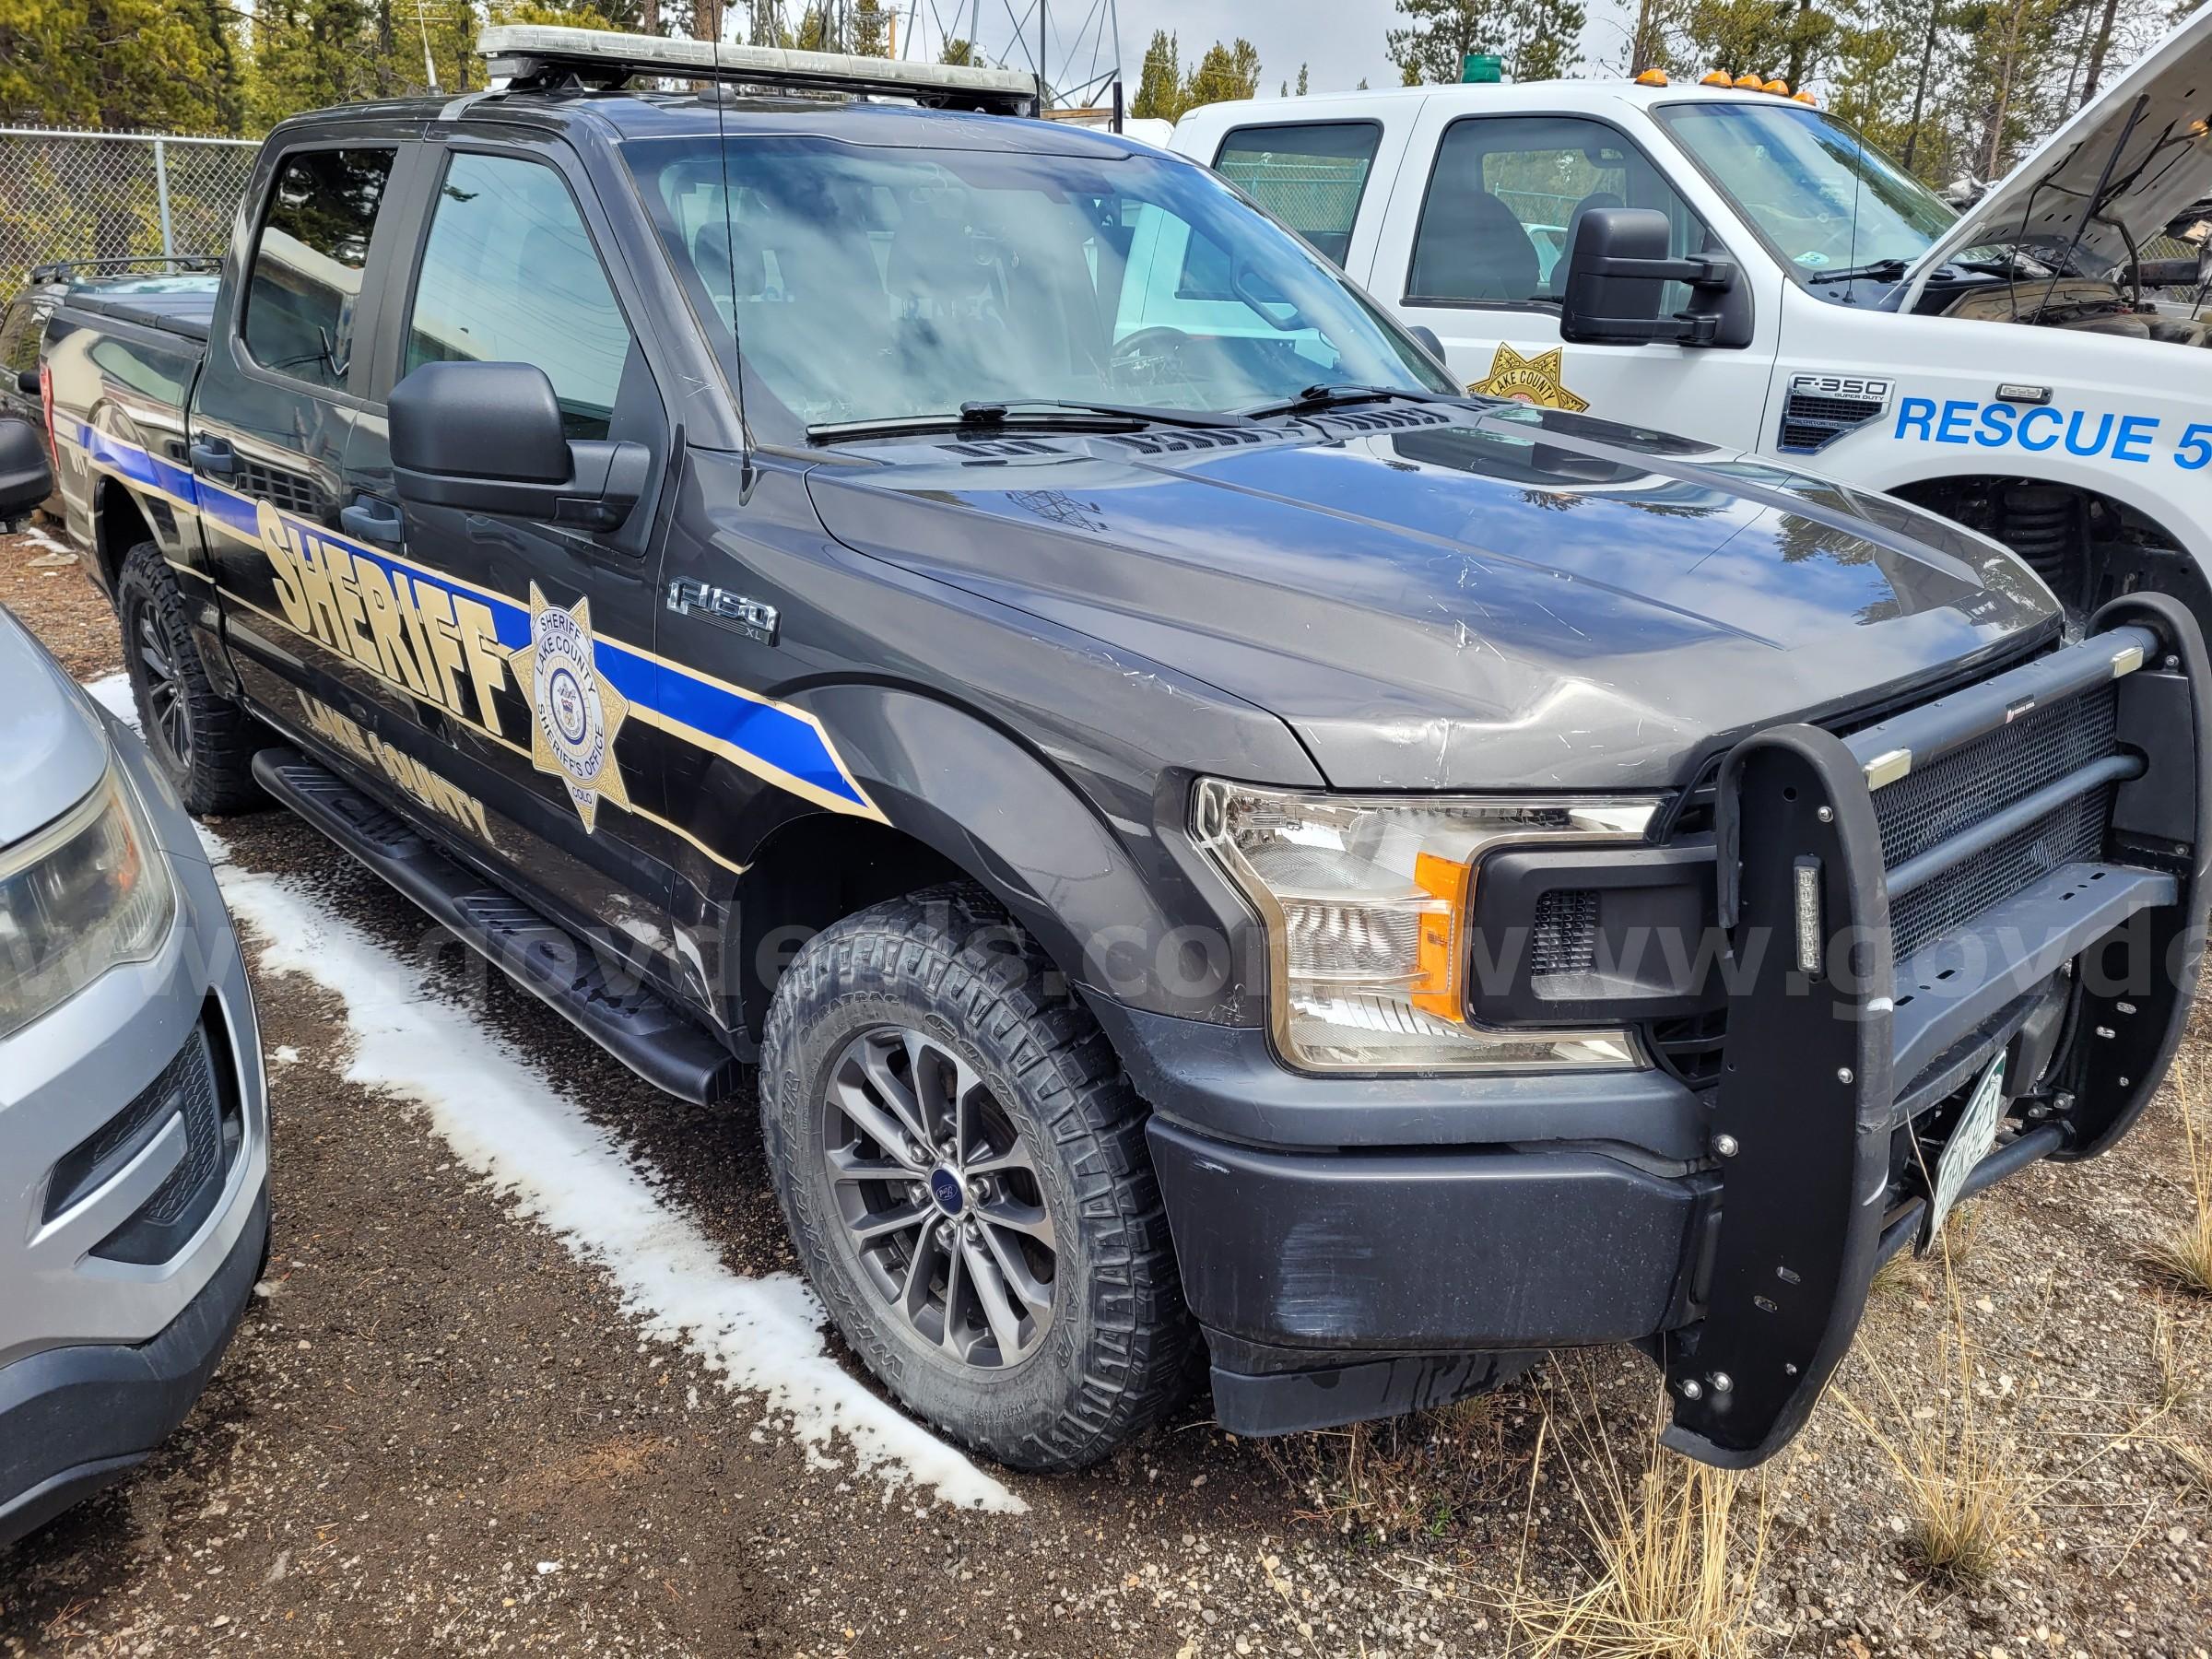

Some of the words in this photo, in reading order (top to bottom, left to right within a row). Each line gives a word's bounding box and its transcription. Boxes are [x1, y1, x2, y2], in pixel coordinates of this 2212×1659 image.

[1489, 372, 1516, 396] LAKE
[1520, 370, 1556, 401] COUNTY
[1894, 396, 2161, 464] RESCUE
[2173, 423, 2212, 470] 5
[255, 496, 509, 738] SHERIFF
[540, 613, 582, 641] SHERIFF
[745, 627, 761, 641] XL
[535, 638, 555, 676] LAKE
[556, 636, 596, 695] COUNTY
[295, 687, 377, 766] LAKE
[368, 730, 495, 845] COUNTY
[537, 703, 583, 777] SHERIFF'S
[584, 723, 605, 777] OFFICE
[571, 786, 593, 806] COLO
[782, 1068, 904, 1381] WRANGLER
